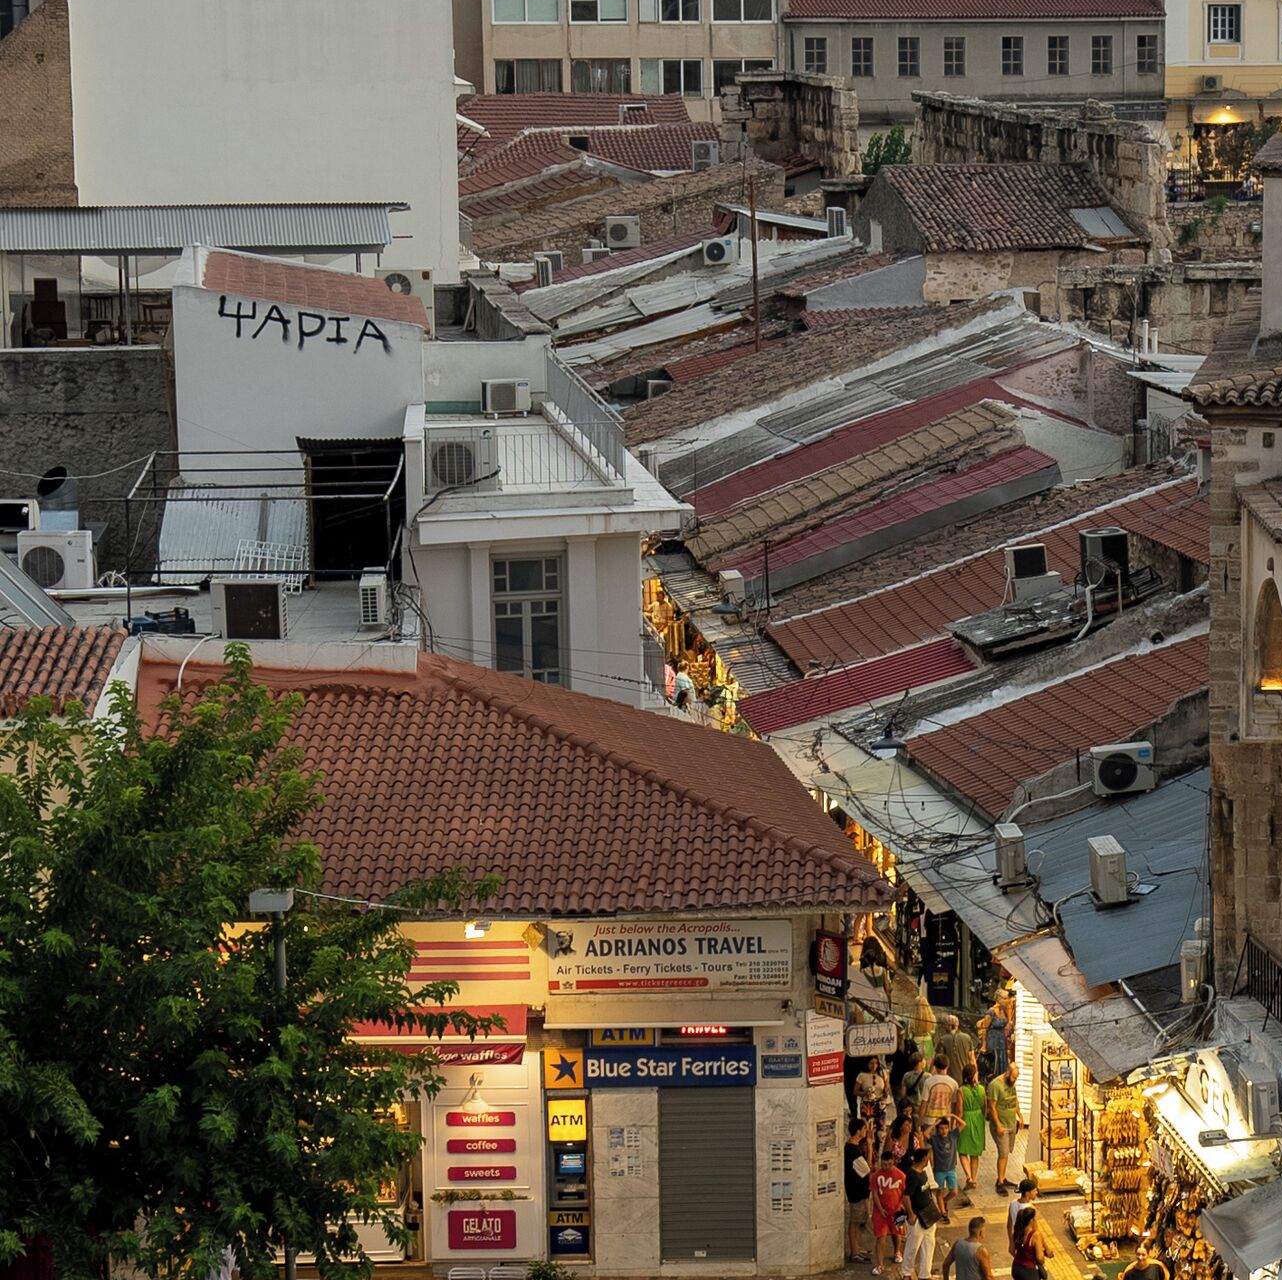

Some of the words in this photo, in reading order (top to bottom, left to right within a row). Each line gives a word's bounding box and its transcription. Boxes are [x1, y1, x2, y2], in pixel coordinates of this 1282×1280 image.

[218, 295, 393, 355] ΨΑΡΙΑ
[594, 924, 617, 937] Just
[619, 923, 654, 935] below
[657, 923, 676, 934] the
[677, 922, 741, 935] Acropolis...
[585, 937, 688, 957] ADRIANOS
[694, 936, 767, 955] TRAVEL
[556, 965, 572, 975] Air
[574, 964, 613, 975] Tickets
[623, 963, 651, 976] Ferry
[655, 963, 692, 974] Tickets
[701, 962, 733, 973] Tours
[820, 1001, 843, 1016] ATM
[601, 1028, 646, 1041] ATM
[461, 1049, 508, 1061] waffles
[587, 1058, 632, 1078] Blue
[636, 1057, 677, 1077] Star
[681, 1056, 750, 1076] Ferries
[462, 1114, 500, 1123] waffles
[551, 1114, 583, 1126] ATM
[466, 1140, 498, 1150] coffee
[464, 1168, 501, 1178] sweets
[556, 1213, 584, 1224] ATM
[463, 1217, 502, 1235] GELATO
